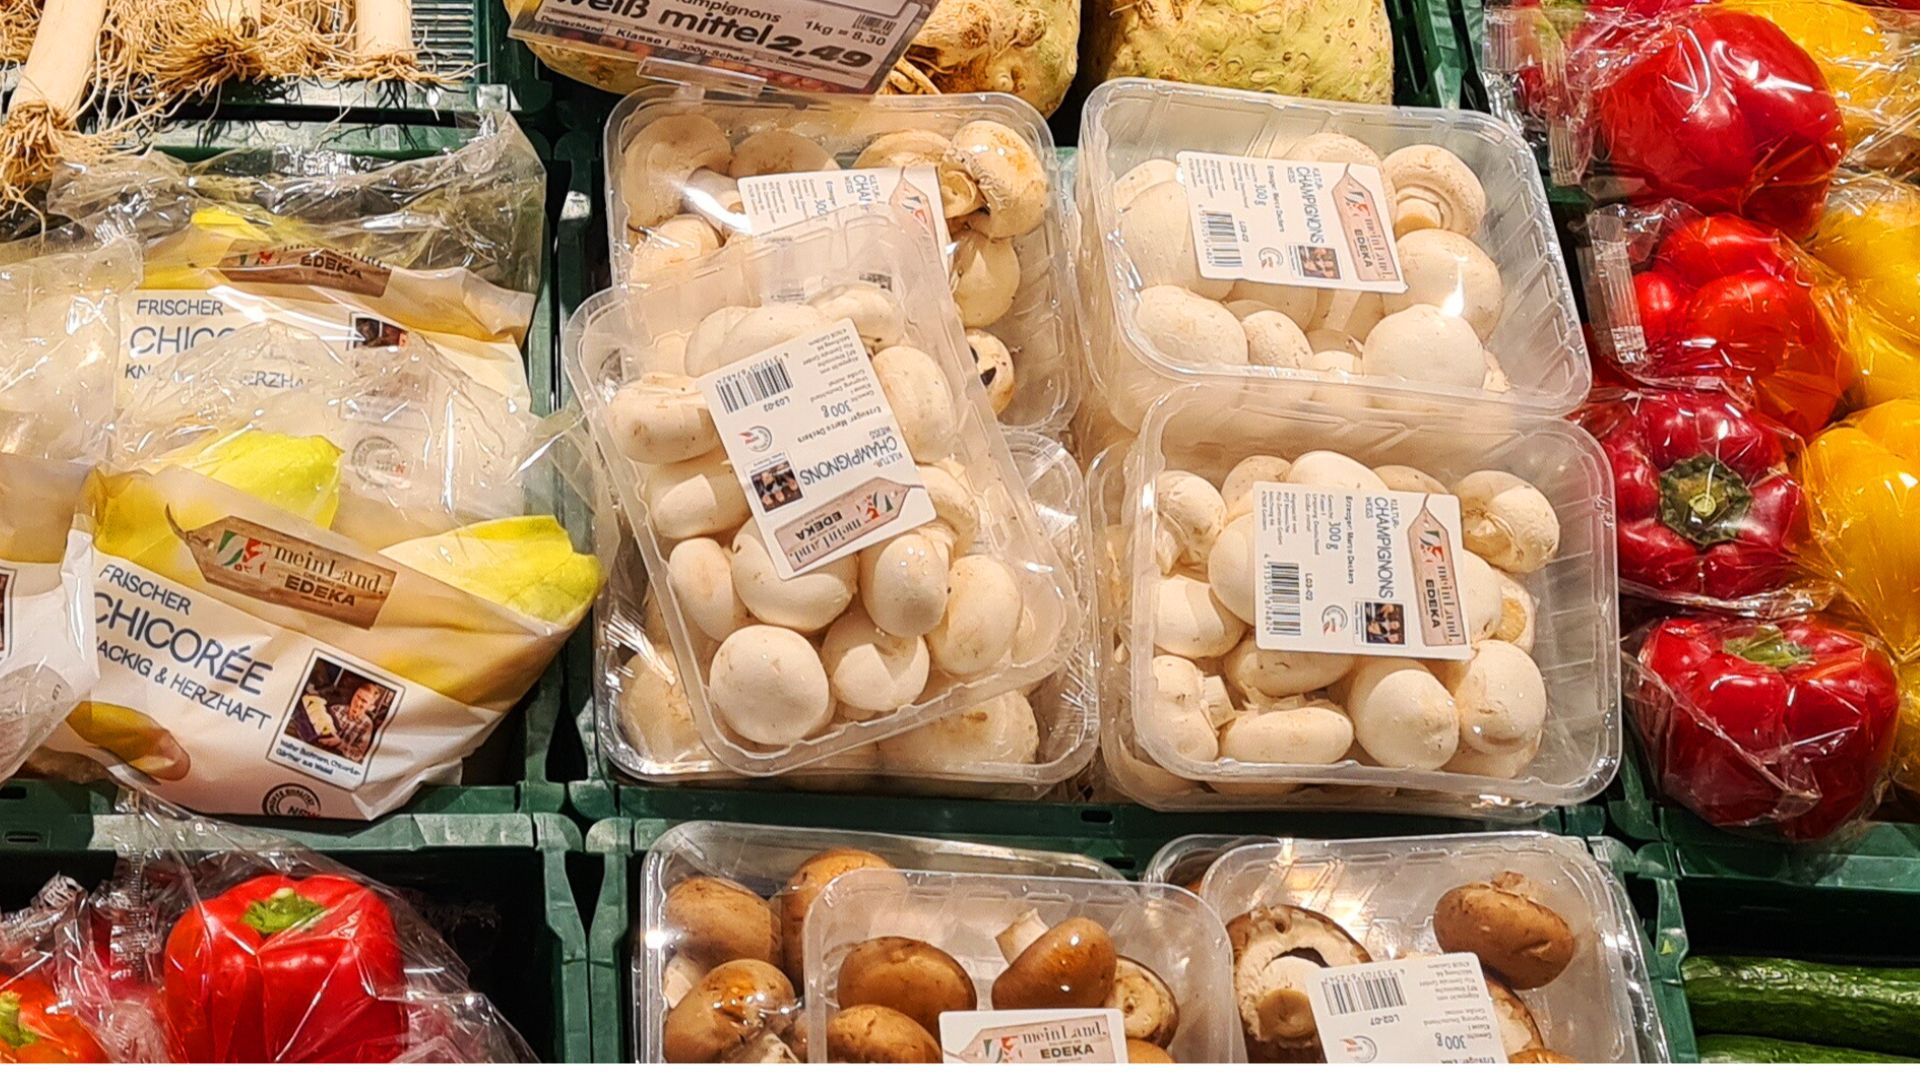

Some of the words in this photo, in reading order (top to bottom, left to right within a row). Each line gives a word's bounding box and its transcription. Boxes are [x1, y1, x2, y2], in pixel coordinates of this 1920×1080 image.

[541, 14, 604, 33] Deutschland
[616, 28, 662, 45] Klasse
[658, 9, 773, 45] mittel
[804, 20, 834, 36] 1kg
[851, 31, 887, 47] 8,30
[765, 35, 873, 68] 2,49
[1254, 184, 1268, 199] 300
[1295, 166, 1324, 244] CHAMPIGNONS
[1354, 229, 1373, 267] EDEKA
[301, 254, 363, 279] EDEKA
[137, 299, 223, 316] FRISCHER
[819, 403, 831, 418] g
[828, 399, 852, 418] 300
[796, 427, 826, 445] Deckers
[825, 418, 847, 432] Marco
[797, 432, 899, 486] CHAMPIGNONS
[794, 510, 842, 541] EDEKA
[1328, 521, 1341, 542] 300
[1346, 531, 1354, 553] Marco
[1374, 496, 1393, 599] CHAMPIGNONS
[1347, 555, 1355, 584] Deckers
[98, 563, 192, 616] FRISCHER
[284, 574, 355, 607] EDEKA
[1425, 579, 1440, 628] EDEKA
[94, 591, 274, 695] CHICORÉE
[154, 666, 168, 685] &
[169, 673, 272, 730] HERZHAFT
[1041, 1044, 1094, 1059] EDEKA
[1445, 1035, 1466, 1049] 300
